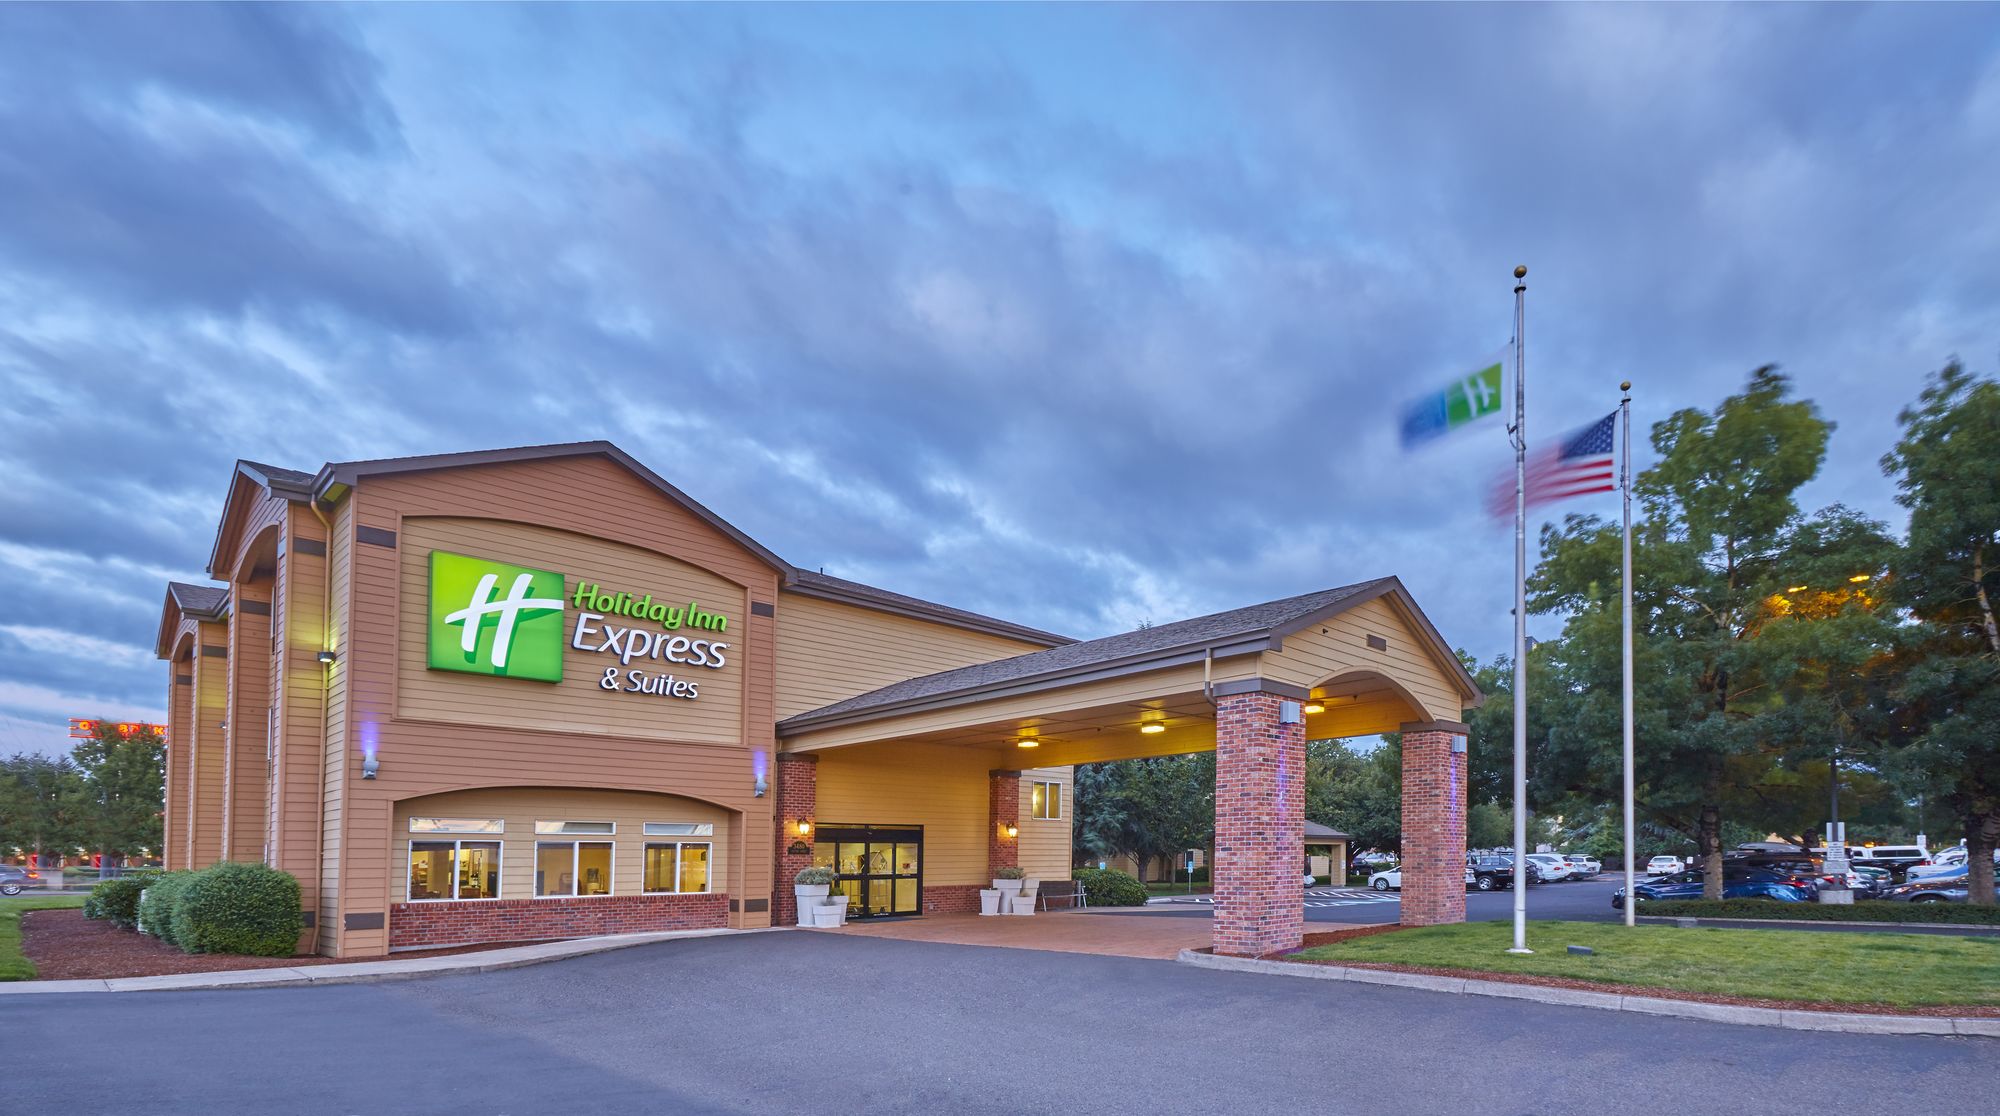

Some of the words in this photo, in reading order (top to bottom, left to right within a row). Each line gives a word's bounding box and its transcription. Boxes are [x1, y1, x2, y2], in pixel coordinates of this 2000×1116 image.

[571, 581, 685, 631] Holiday
[686, 601, 728, 632] Inn
[571, 612, 728, 669] Express
[600, 667, 620, 690] &
[624, 670, 699, 699] Suites
